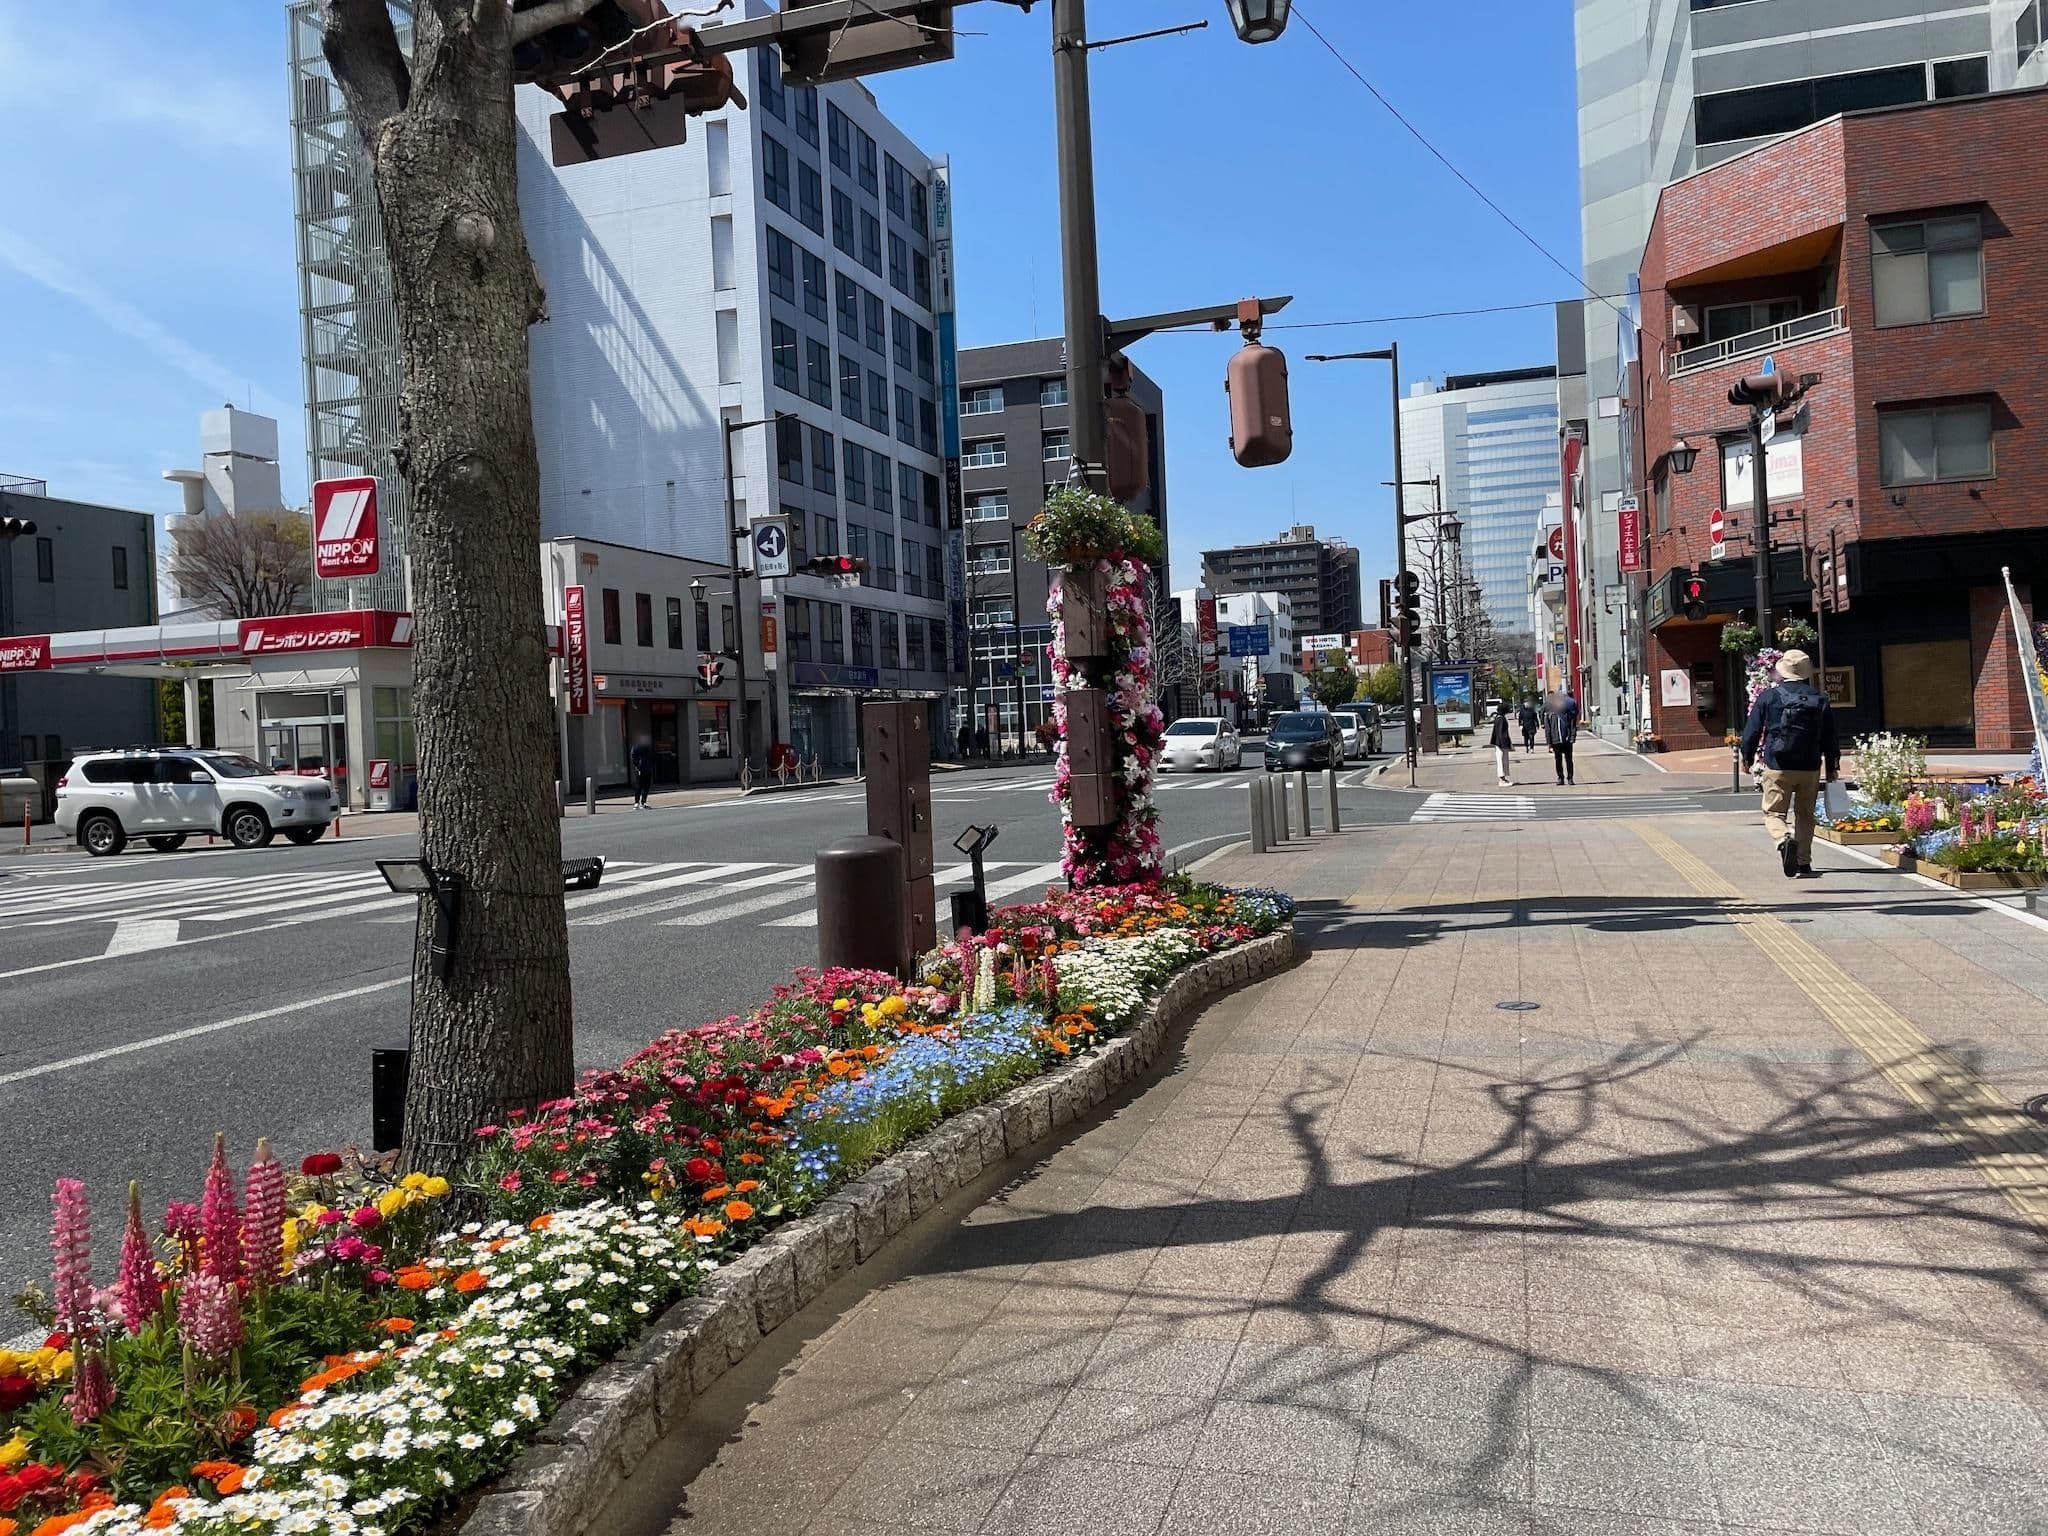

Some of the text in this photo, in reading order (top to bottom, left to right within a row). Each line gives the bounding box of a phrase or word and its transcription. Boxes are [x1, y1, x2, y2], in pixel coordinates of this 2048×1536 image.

[318, 540, 374, 558] NIPPON
[263, 630, 361, 650] ニッポンレンタカー
[0, 646, 41, 661] NIPPON
[569, 613, 584, 708] ニッポンレンタカー
